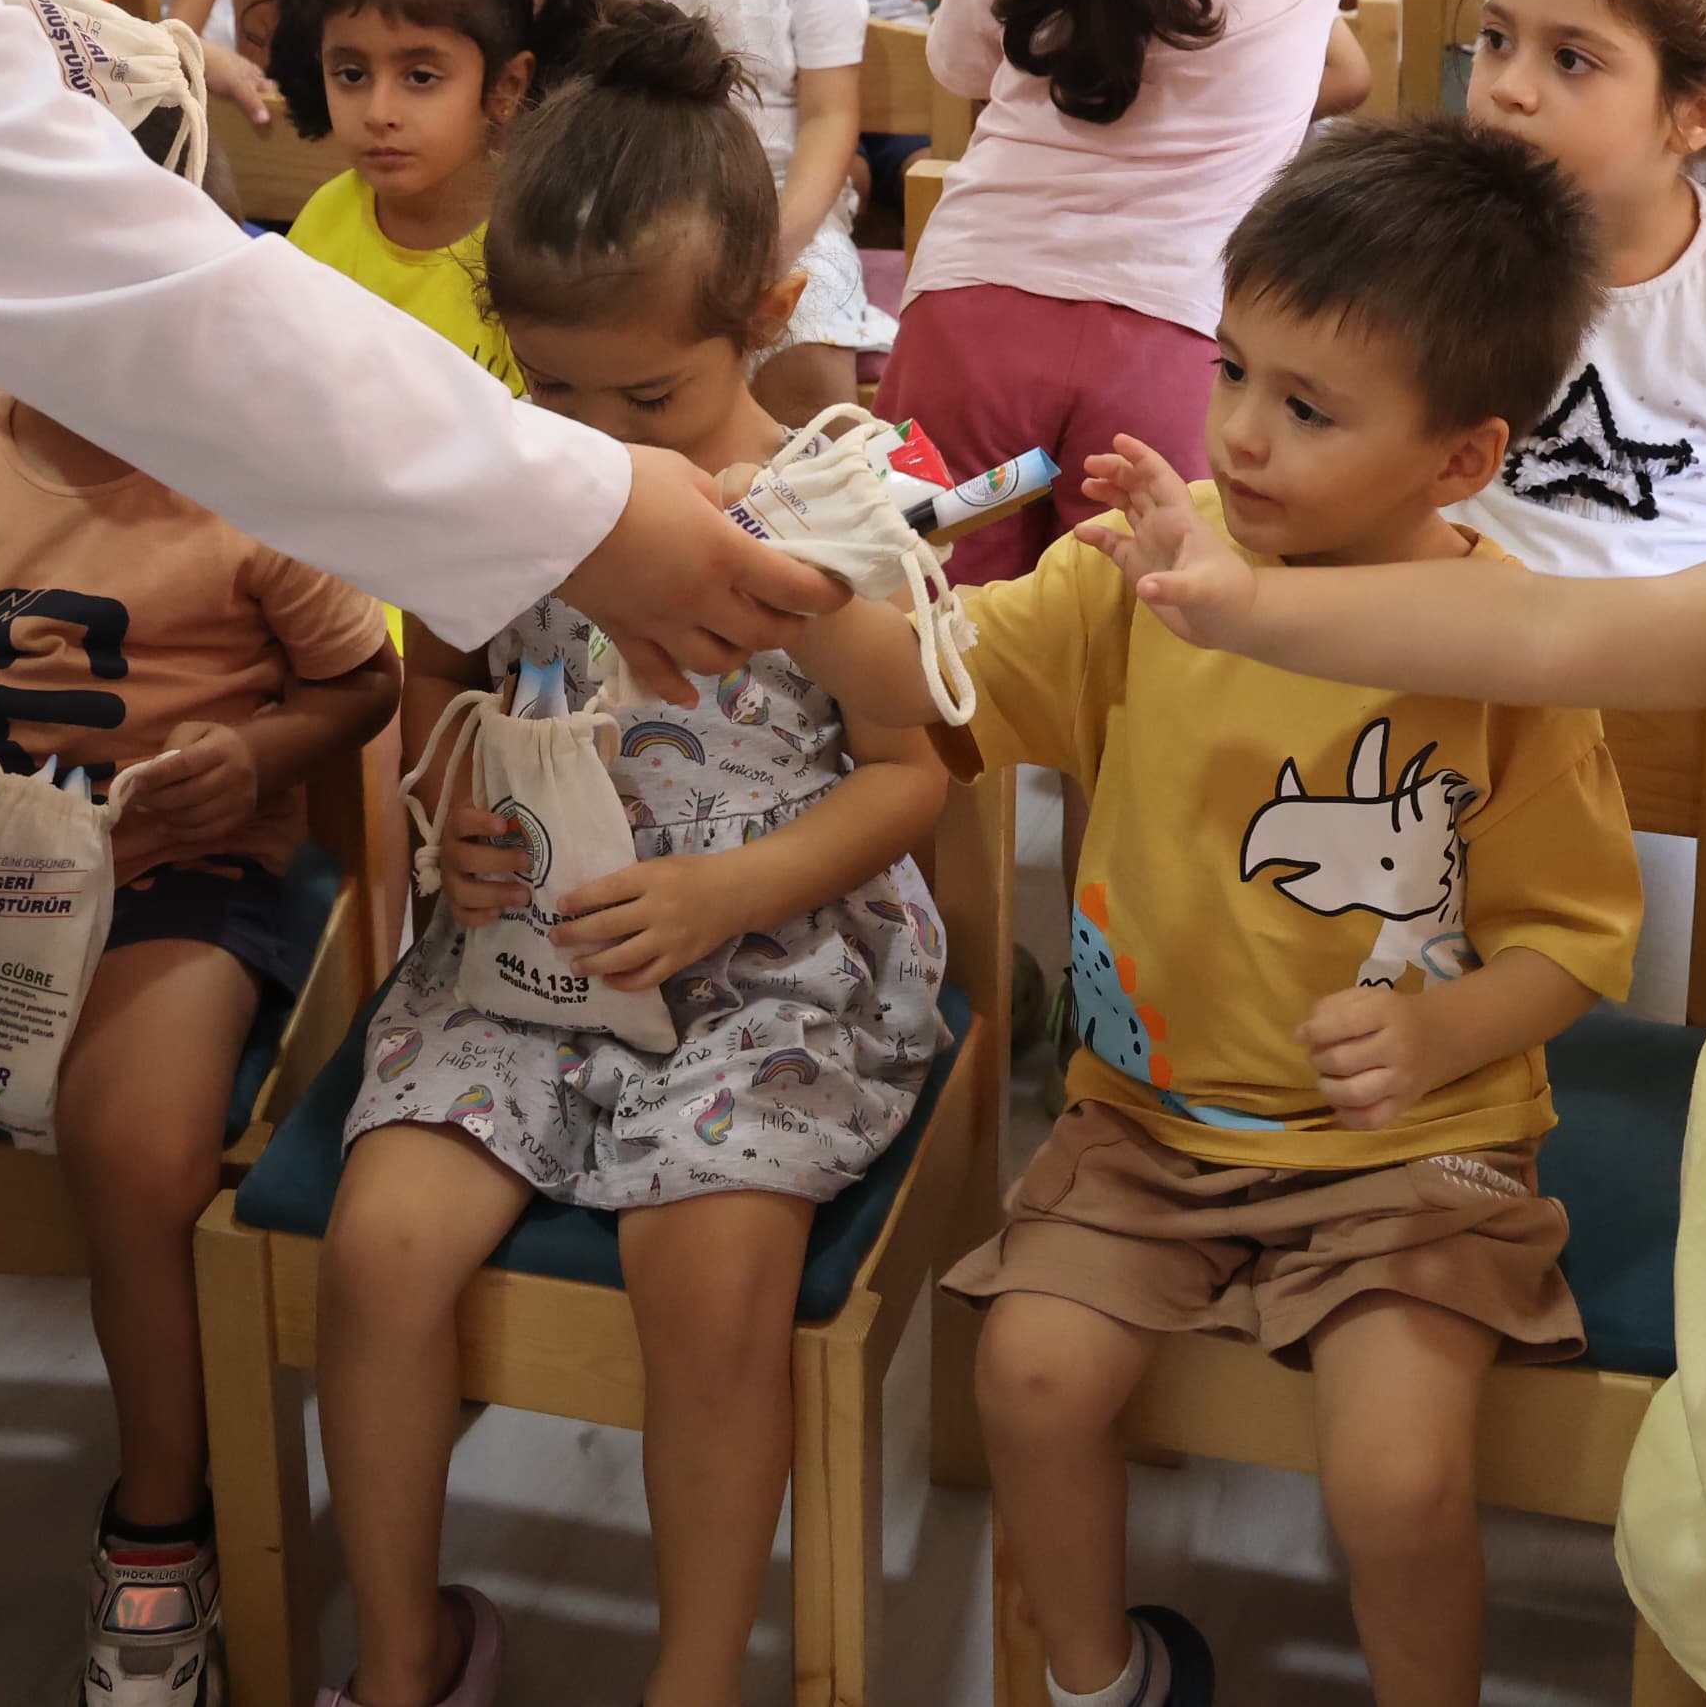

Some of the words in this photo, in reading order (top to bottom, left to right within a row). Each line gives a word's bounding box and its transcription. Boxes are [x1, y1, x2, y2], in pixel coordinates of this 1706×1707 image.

[1, 962, 54, 988] GÜBRE
[495, 952, 526, 978] 444
[530, 967, 542, 986] 4
[547, 974, 590, 993] 133
